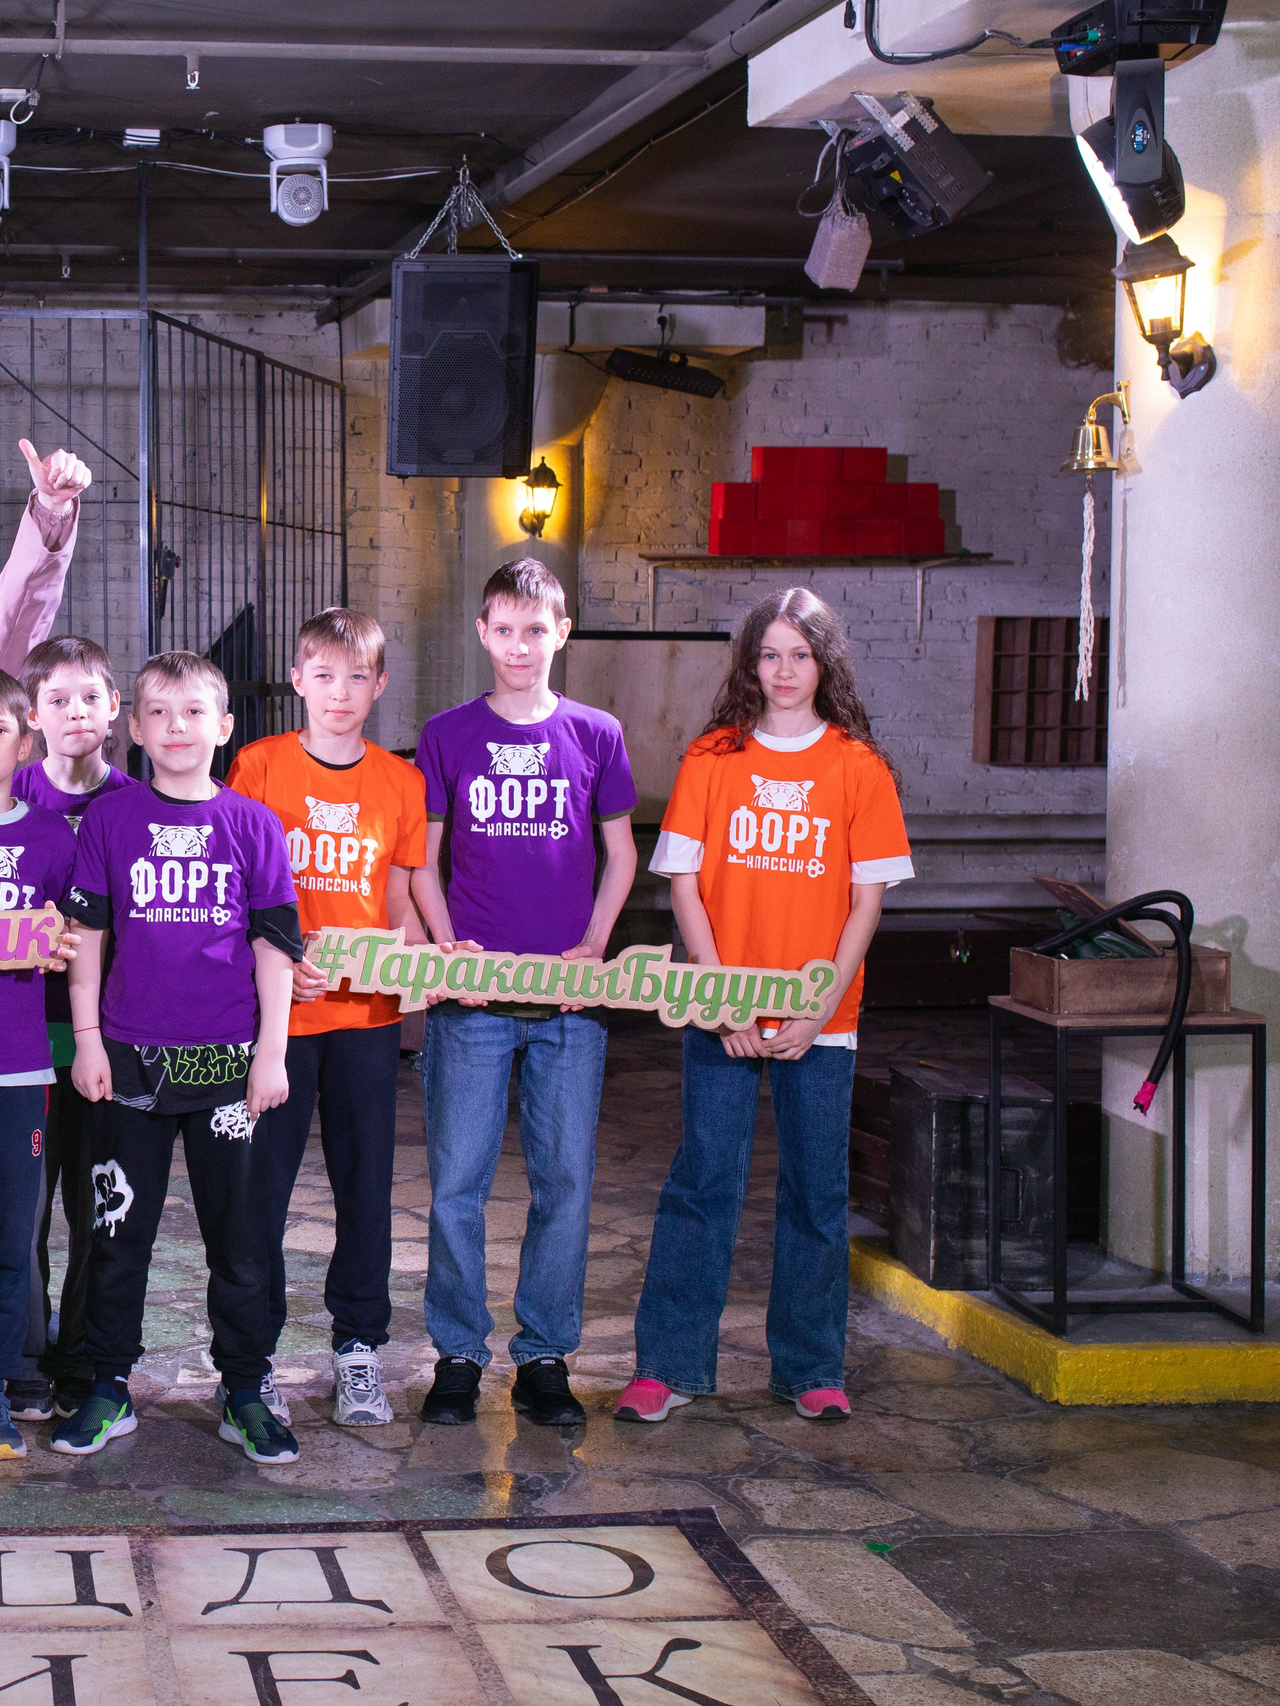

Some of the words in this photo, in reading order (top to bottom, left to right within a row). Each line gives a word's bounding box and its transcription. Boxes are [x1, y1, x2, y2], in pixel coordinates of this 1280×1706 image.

[469, 775, 570, 822] ФОРТ
[285, 827, 379, 876] ФОРТ
[487, 822, 547, 836] КЛАССИК
[729, 805, 831, 857] ФОРТ
[130, 857, 233, 907] ФОРТ
[300, 875, 358, 892] КЛАССИК
[746, 855, 804, 873] КЛАССИК
[146, 908, 208, 922] КЛАССИК
[312, 934, 834, 1023] #ТараканыБудут?
[31, 1129, 42, 1156] 9
[201, 1546, 393, 1615] Д
[485, 1540, 655, 1598] О
